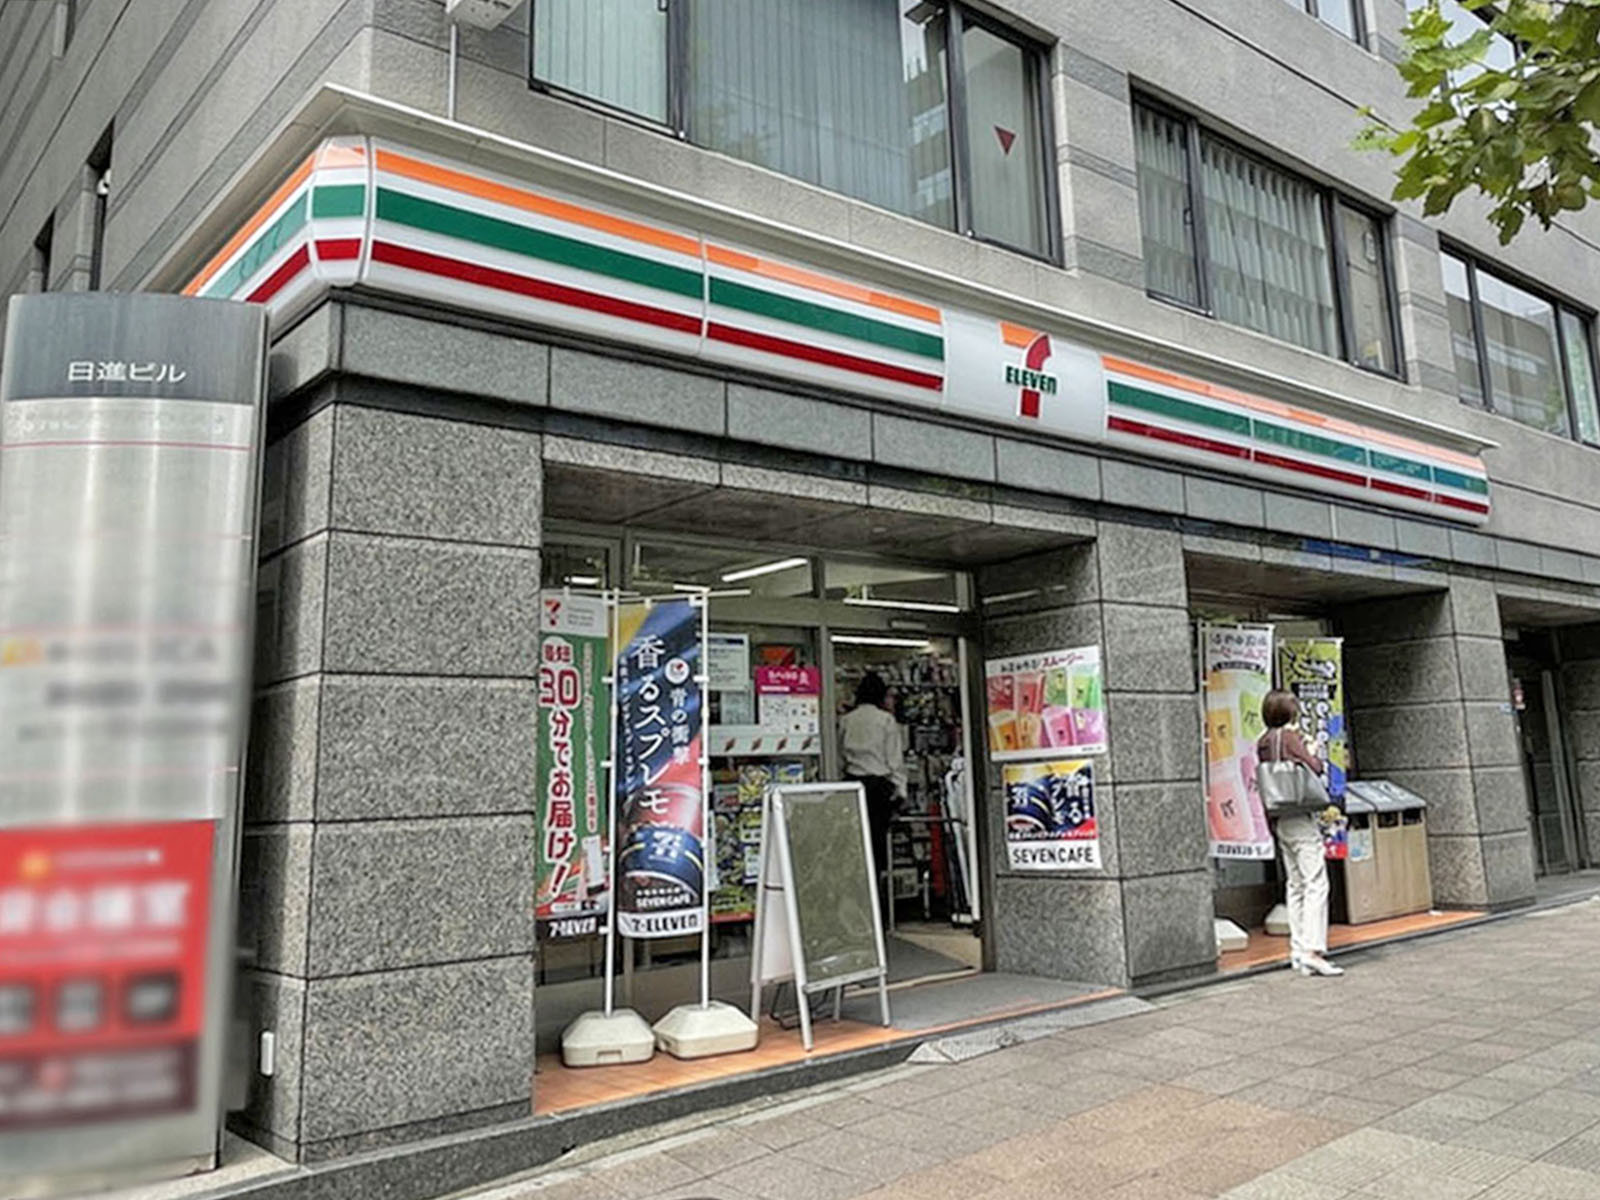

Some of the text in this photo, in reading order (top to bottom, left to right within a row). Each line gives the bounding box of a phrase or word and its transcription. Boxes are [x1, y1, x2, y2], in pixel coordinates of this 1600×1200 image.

[67, 360, 187, 383] 日進ビル
[630, 633, 671, 814] 香るスプレモ
